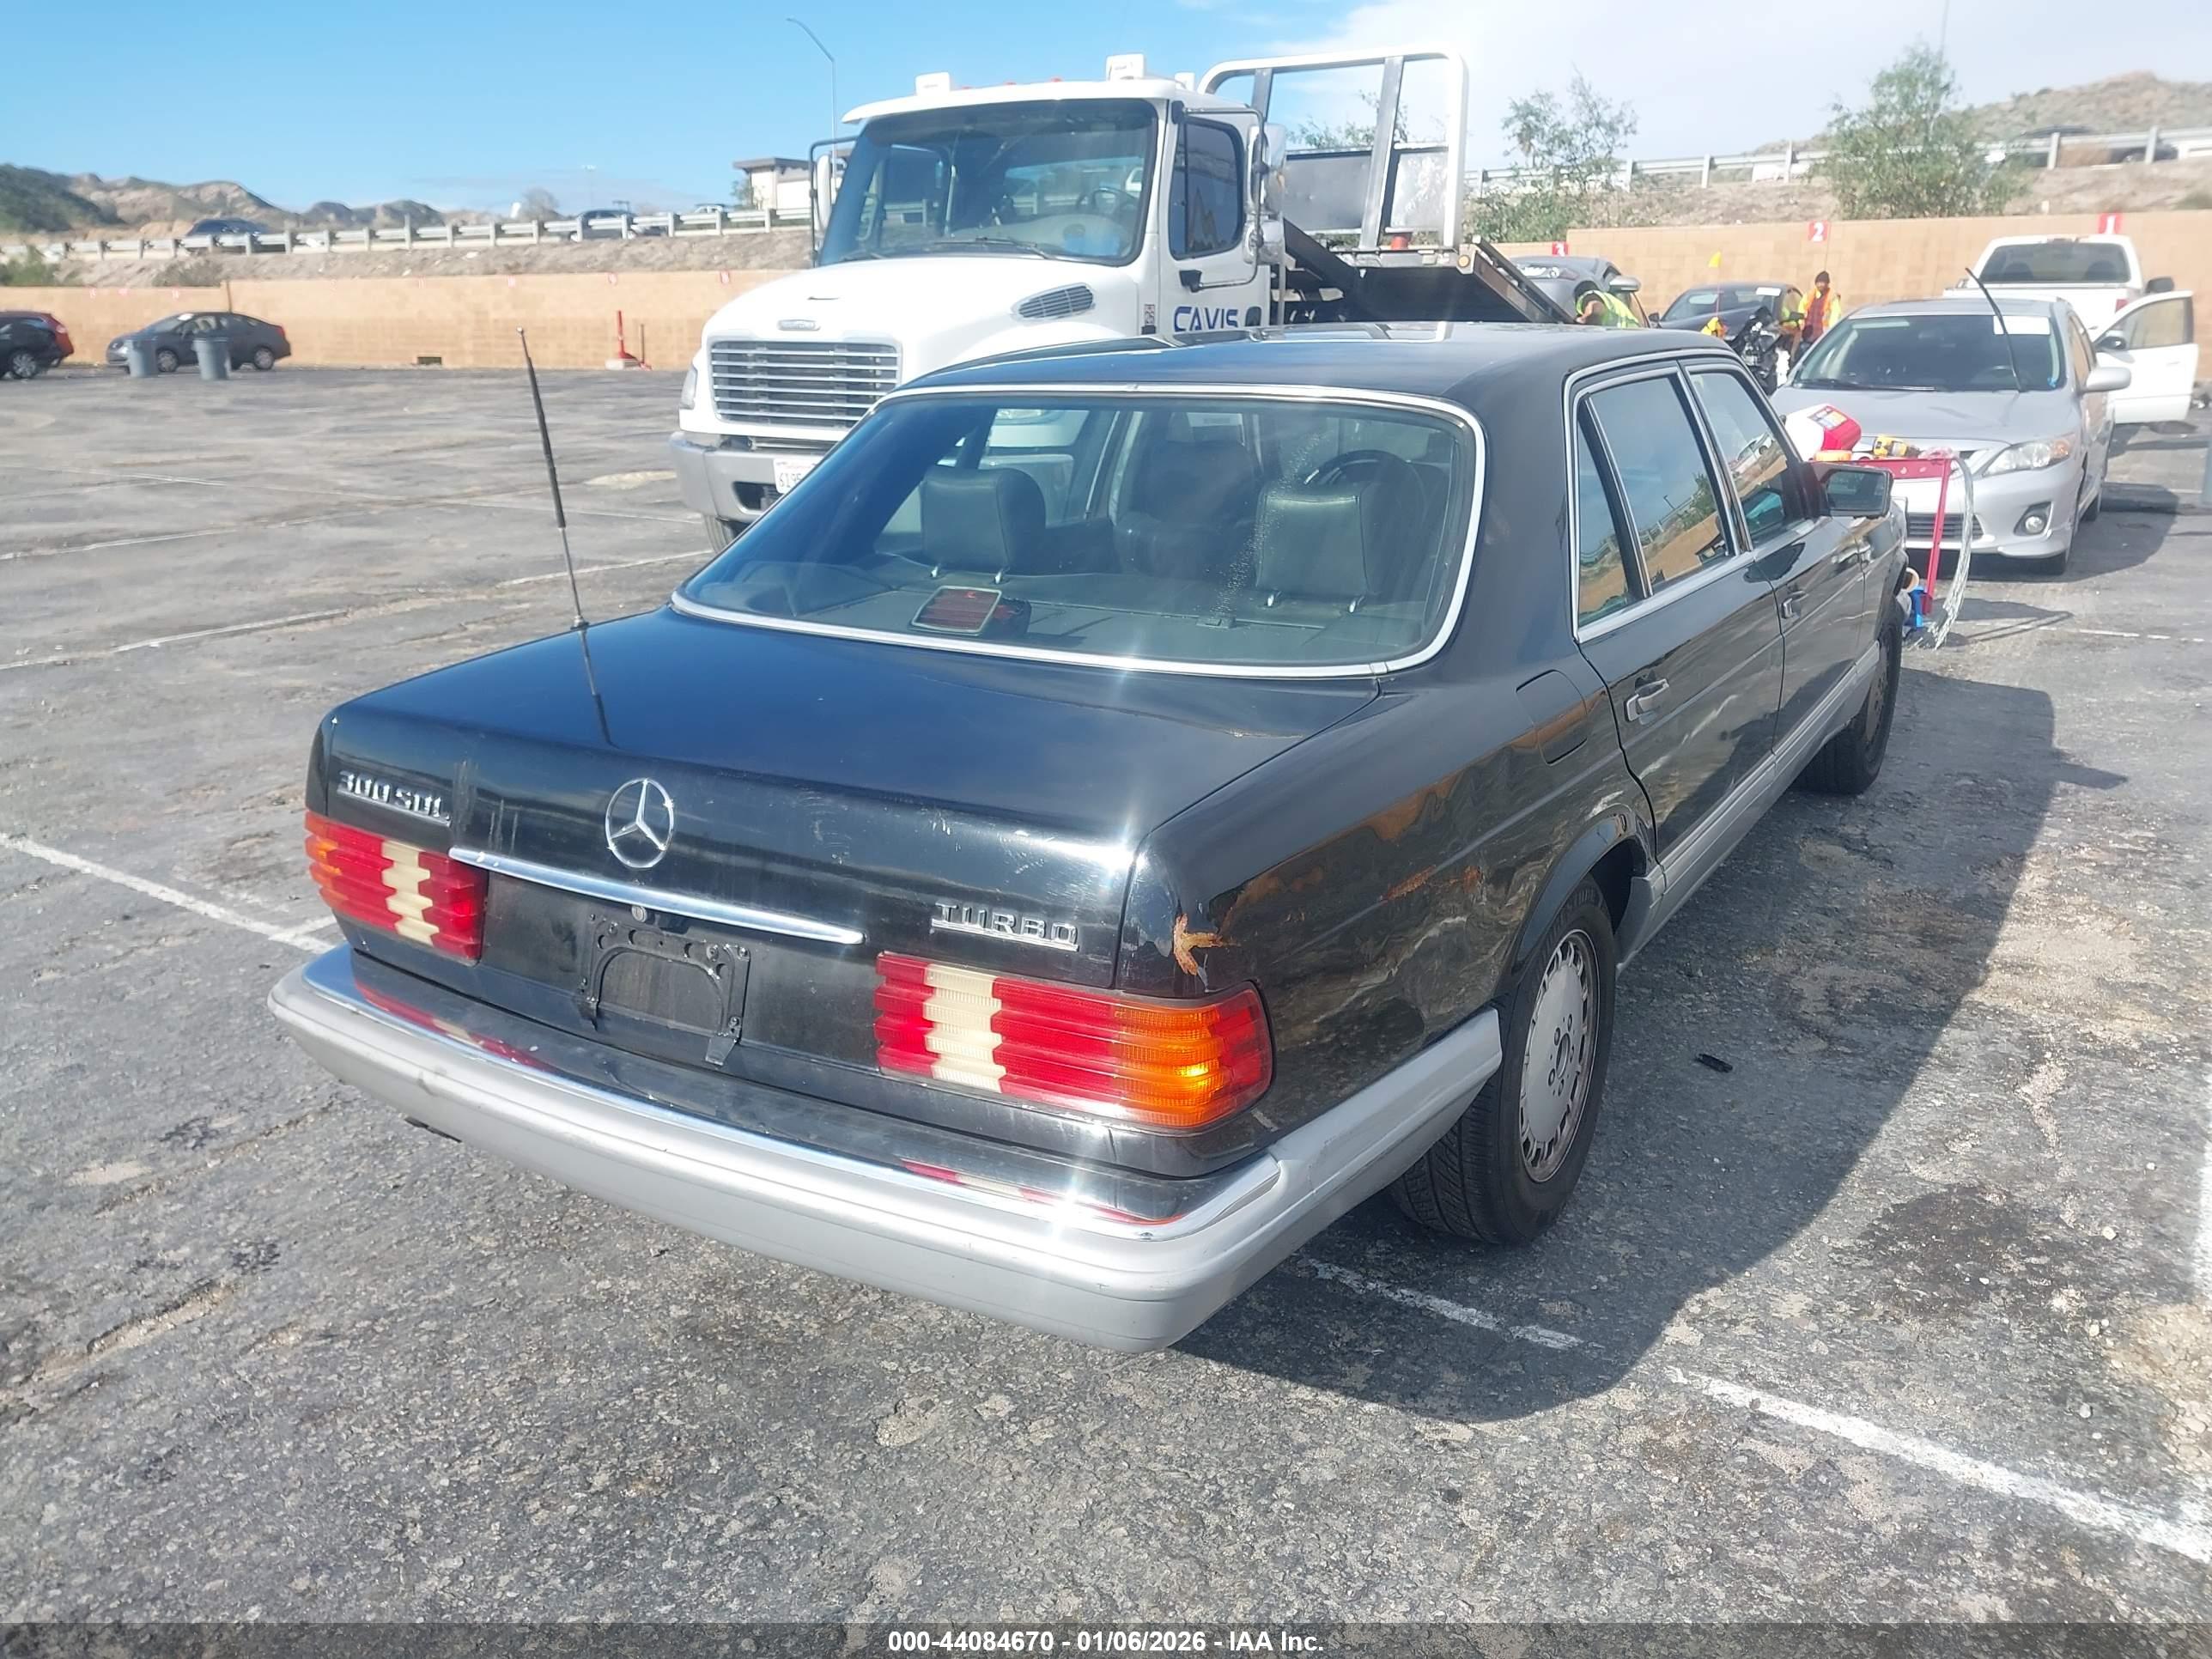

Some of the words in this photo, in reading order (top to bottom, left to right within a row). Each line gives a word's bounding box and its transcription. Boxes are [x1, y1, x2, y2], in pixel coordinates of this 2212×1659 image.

[1811, 222, 1825, 242] 2
[1174, 306, 1238, 332] CAVIS
[337, 770, 390, 804] 300
[934, 901, 1078, 945] TURBO
